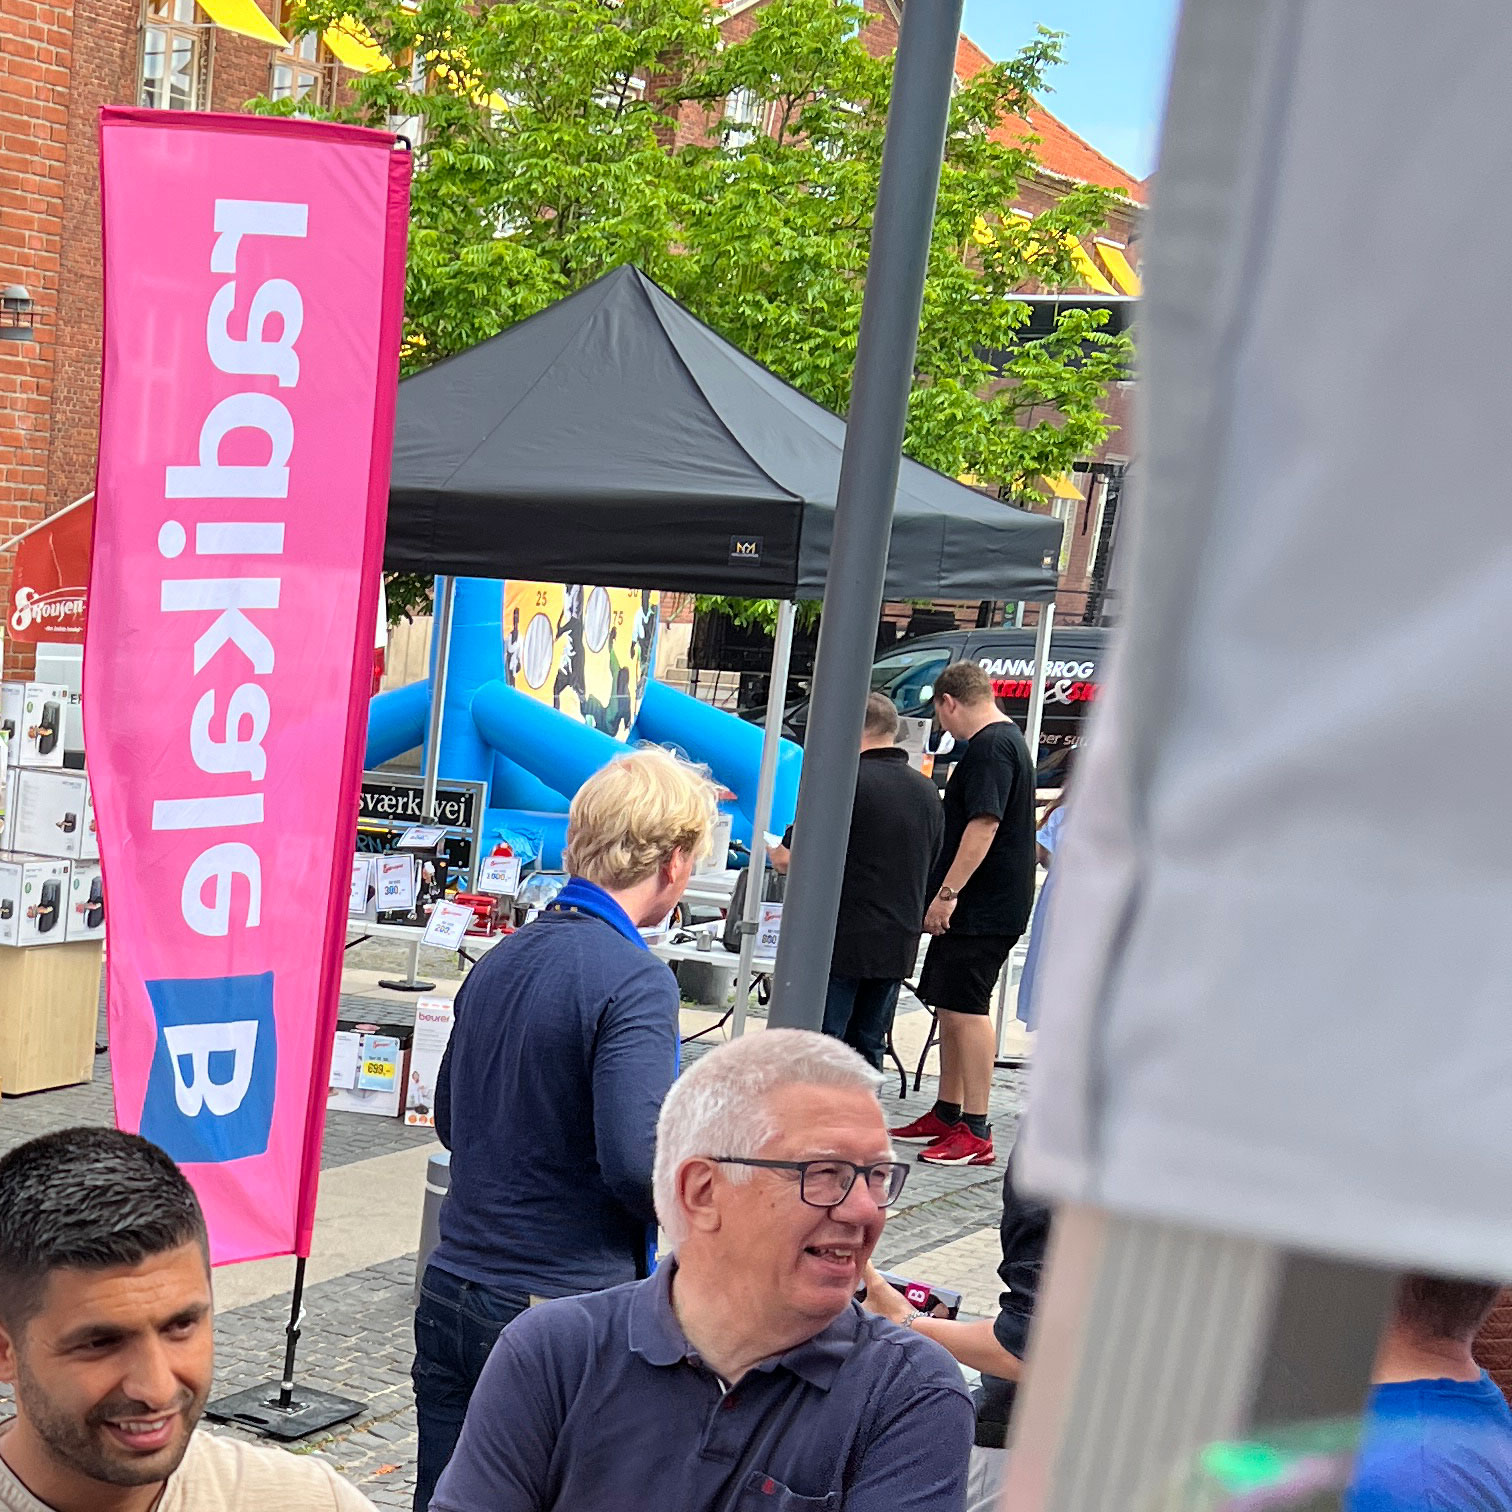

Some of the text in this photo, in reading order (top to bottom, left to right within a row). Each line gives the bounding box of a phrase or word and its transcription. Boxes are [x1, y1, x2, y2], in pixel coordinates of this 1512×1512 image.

[536, 590, 548, 607] 25
[613, 610, 624, 626] 75
[978, 658, 1095, 679] DANNBROG
